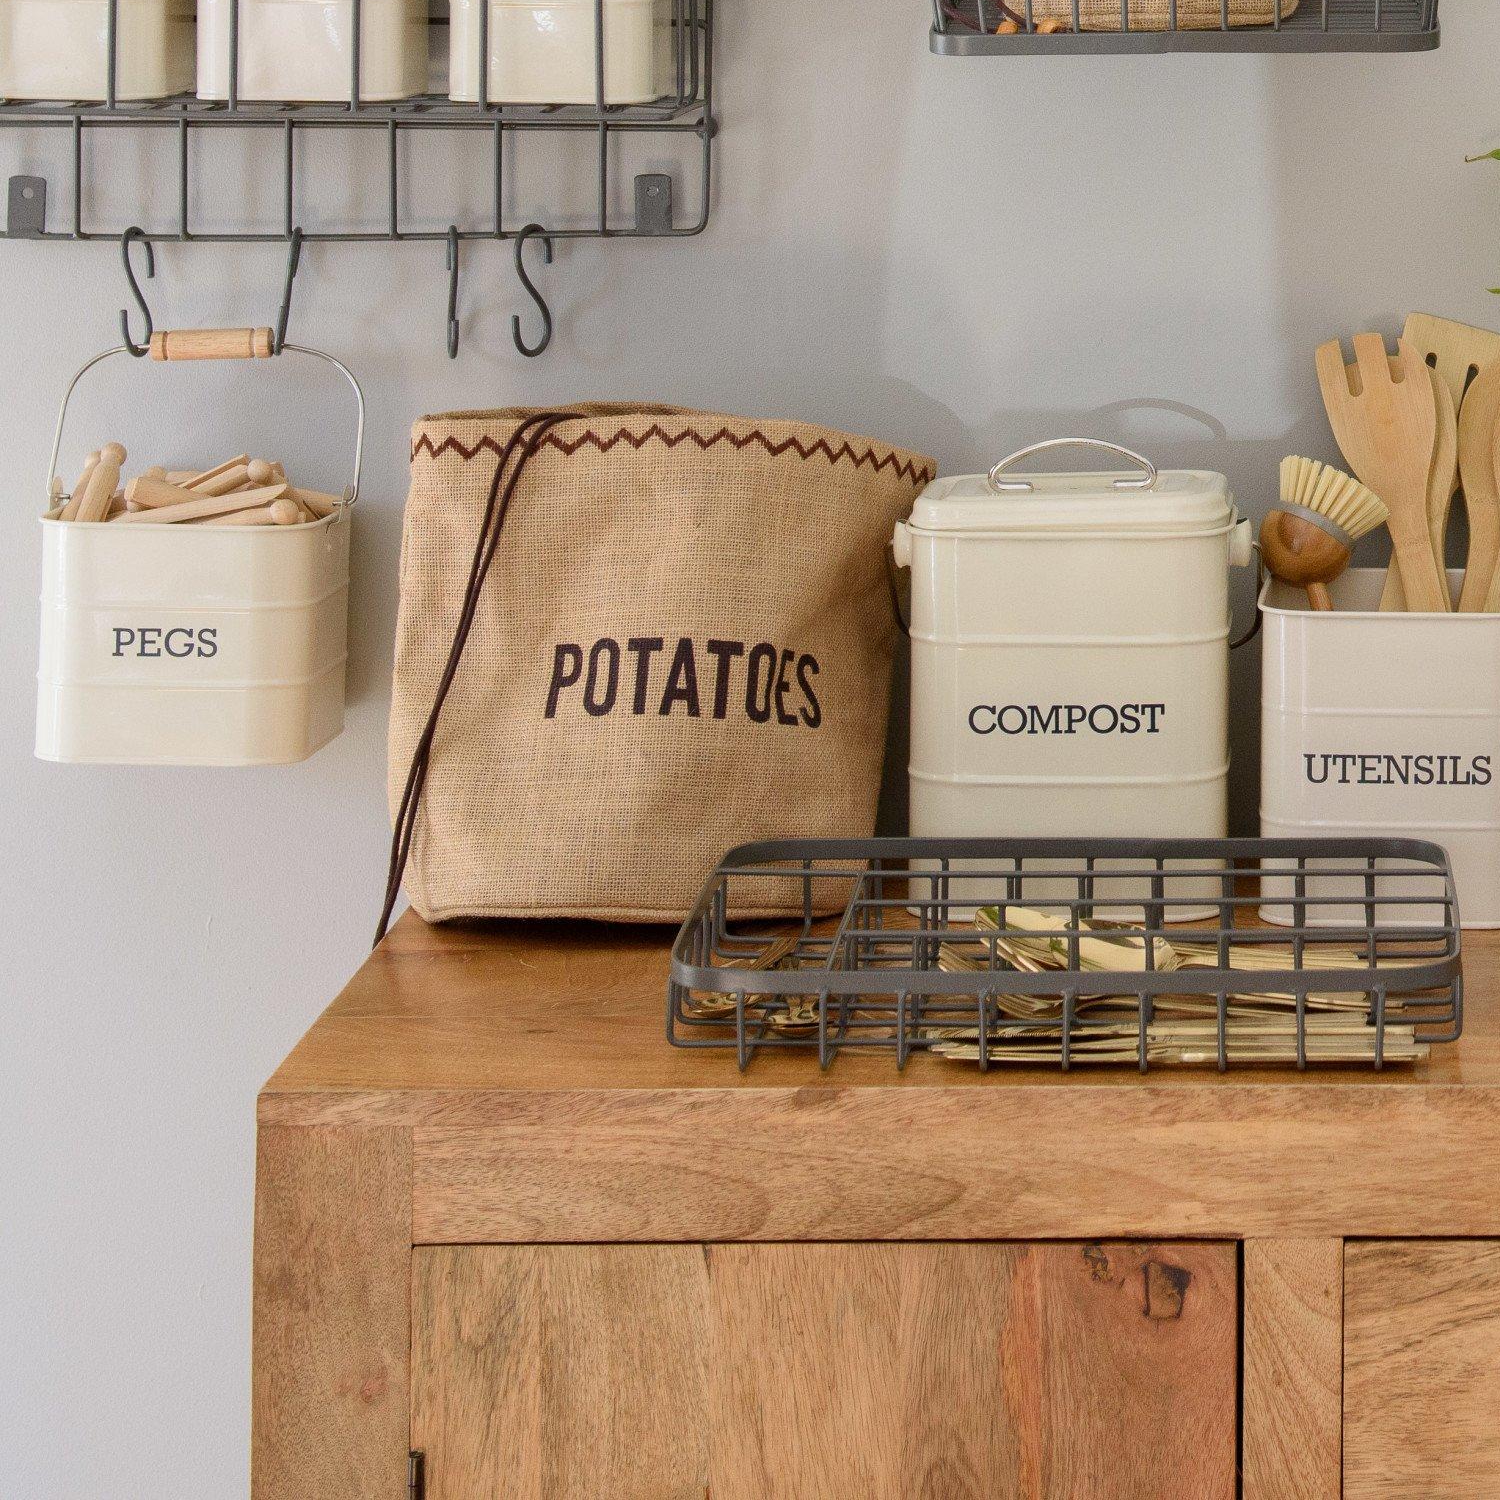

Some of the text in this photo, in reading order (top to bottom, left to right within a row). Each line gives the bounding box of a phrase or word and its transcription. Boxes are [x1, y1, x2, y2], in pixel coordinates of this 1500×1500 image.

[112, 627, 218, 658] PEGS
[544, 636, 822, 729] POTATOES
[968, 703, 1166, 735] COMPOST
[1302, 753, 1492, 786] UTENSILS
